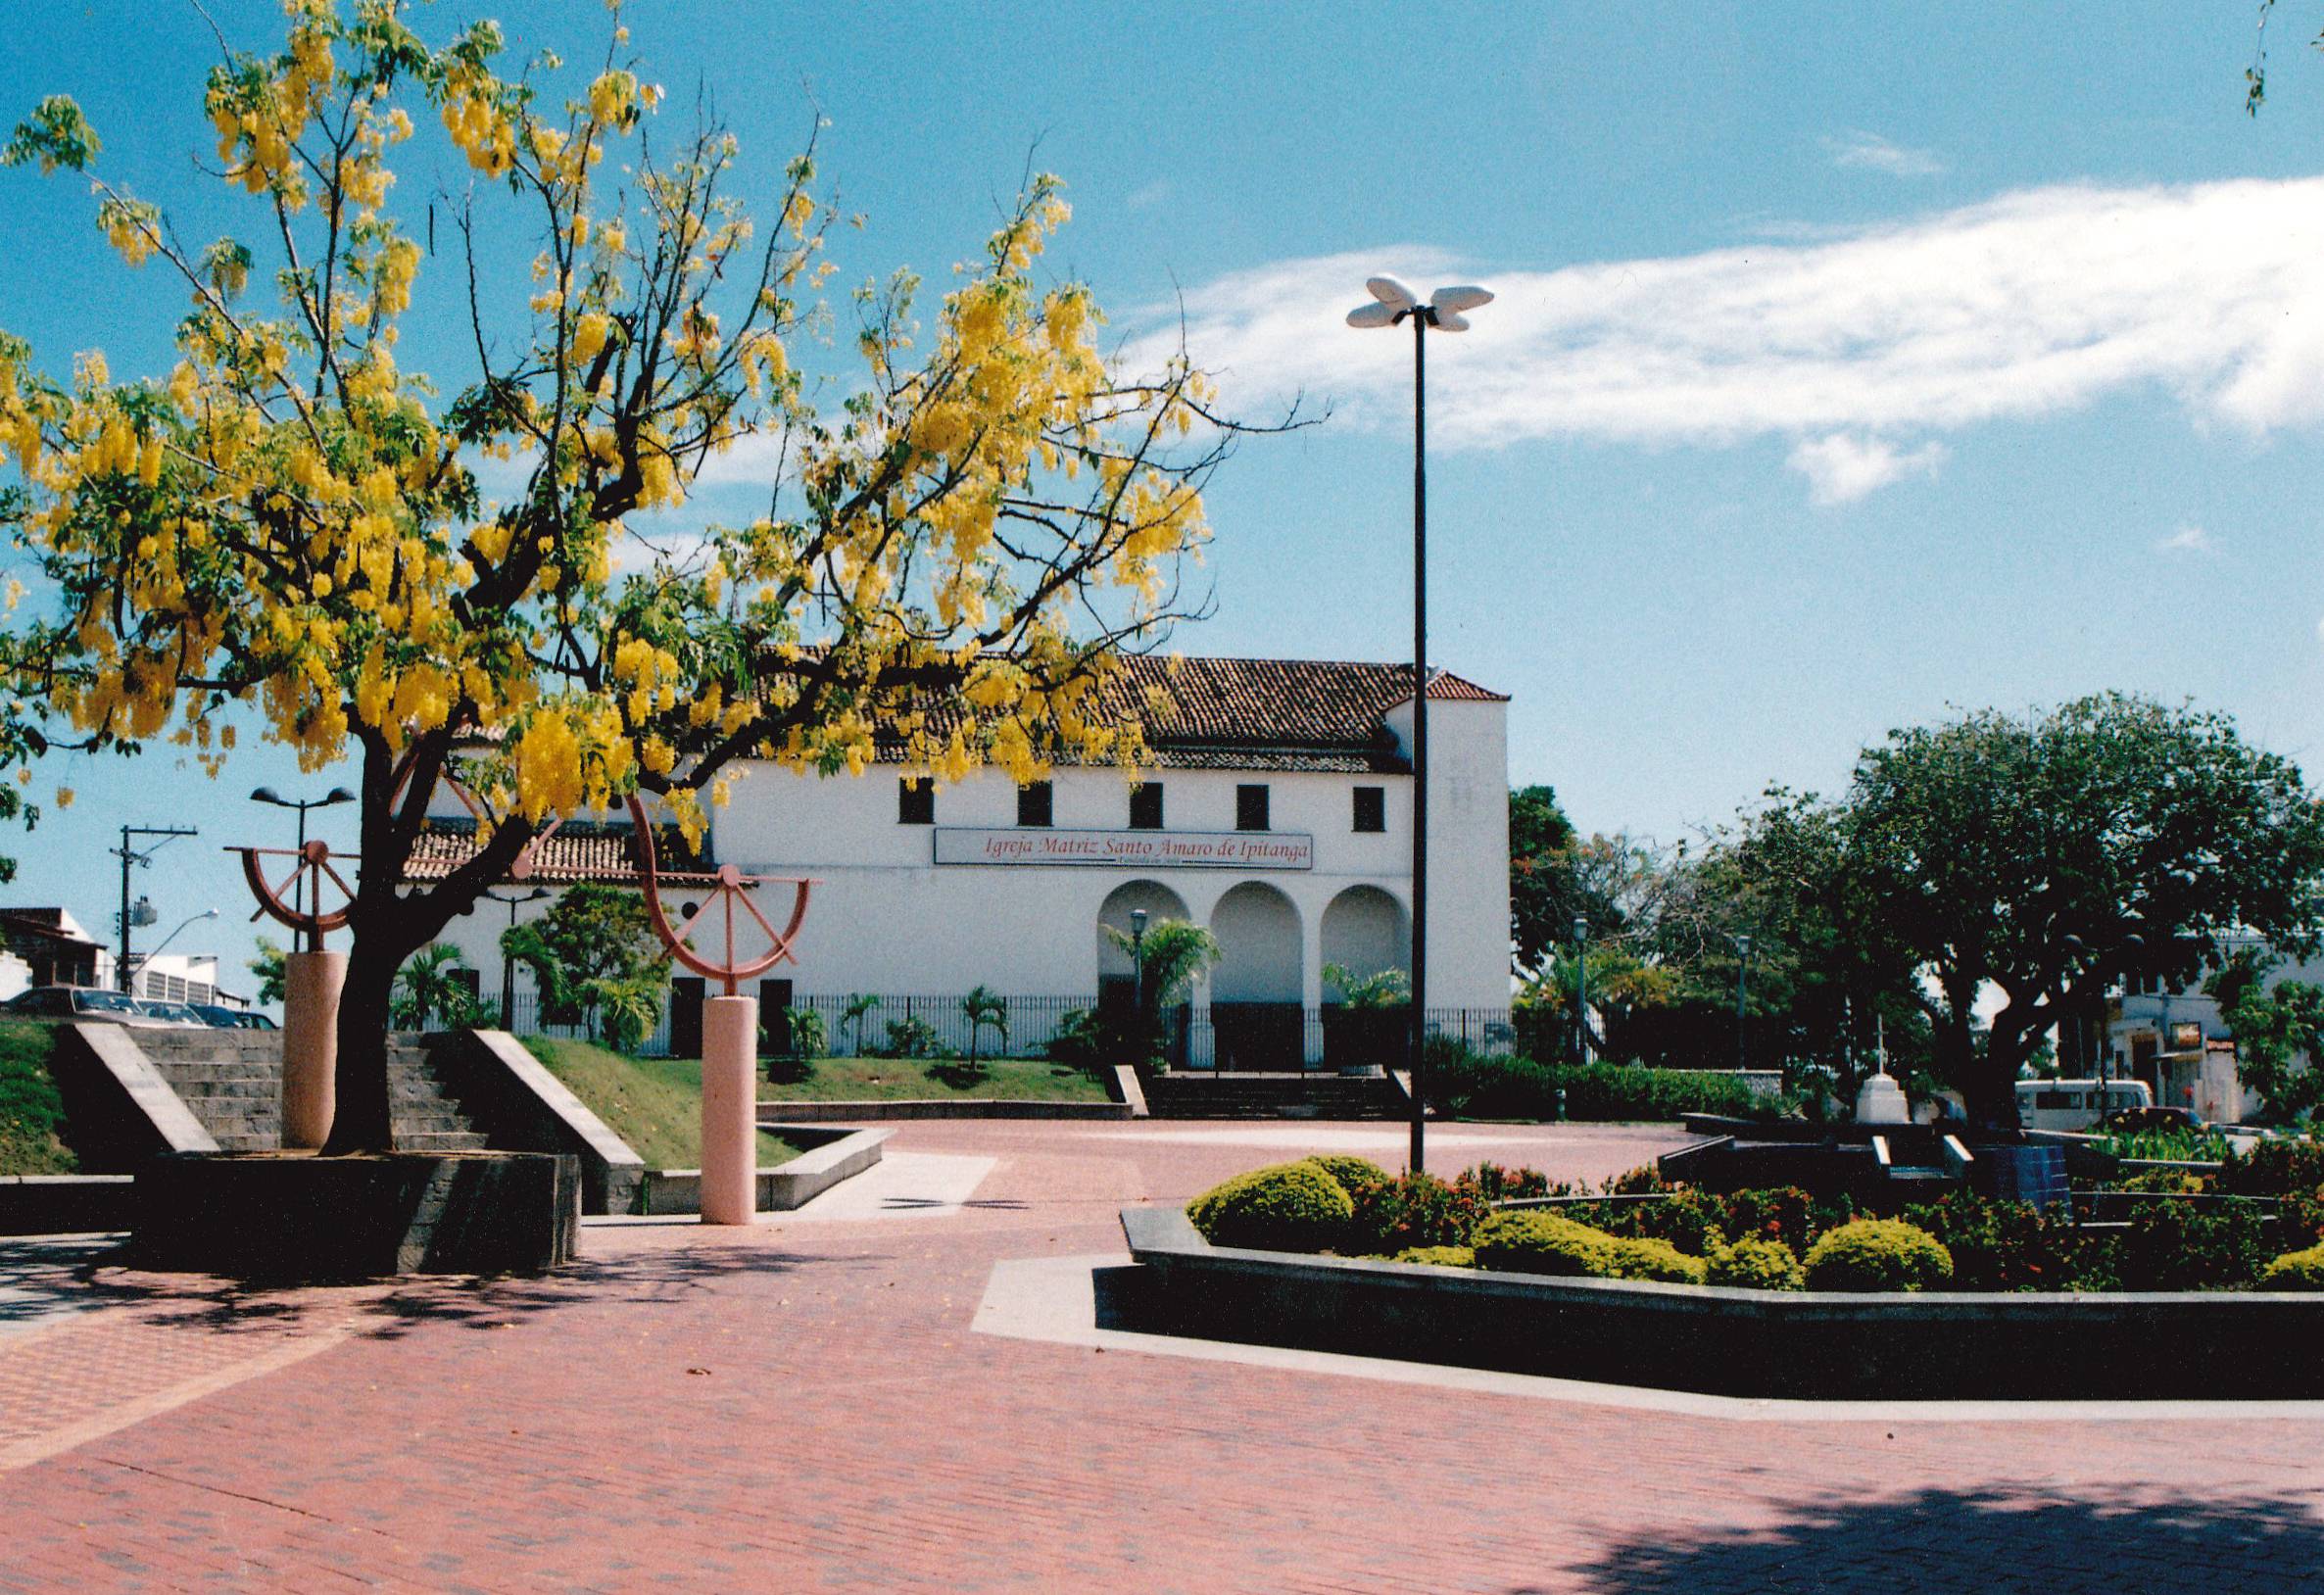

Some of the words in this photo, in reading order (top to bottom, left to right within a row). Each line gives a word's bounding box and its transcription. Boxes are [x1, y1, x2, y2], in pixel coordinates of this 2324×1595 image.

[986, 836, 1033, 858] Igreja
[1039, 837, 1098, 854] Matriz
[1102, 838, 1152, 855] Santo
[1155, 839, 1213, 857] Amaro
[1217, 839, 1235, 856] de
[1239, 840, 1308, 862] Ipitanga
